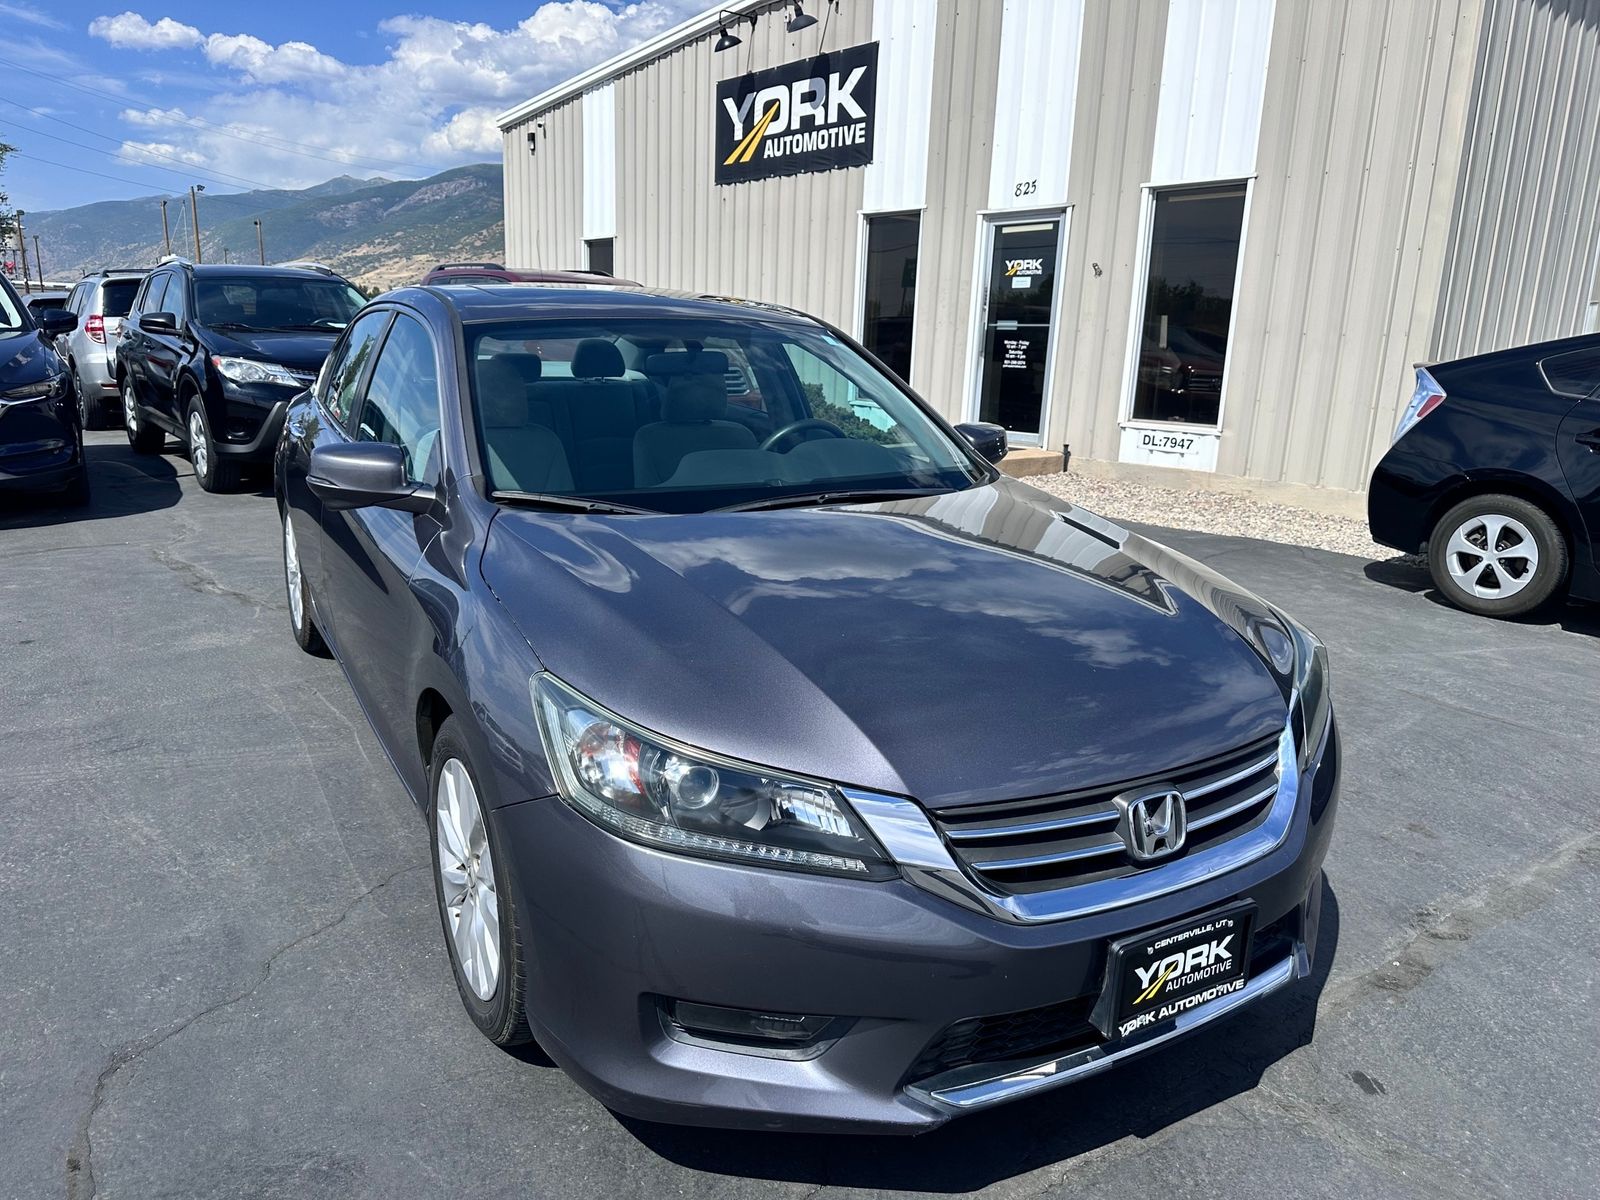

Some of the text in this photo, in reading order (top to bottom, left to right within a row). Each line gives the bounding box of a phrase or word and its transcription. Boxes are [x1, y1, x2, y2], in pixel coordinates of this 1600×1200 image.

[723, 66, 867, 141] YORK
[763, 122, 866, 159] AUTOMOTIVE
[1014, 179, 1037, 197] 825
[1005, 258, 1043, 271] YORK
[1142, 434, 1194, 450] DL:7947
[1154, 919, 1228, 949] CENTERVILLE, UT
[1134, 933, 1235, 989] YORK
[1165, 958, 1232, 992] AUTOMOTIVE
[1118, 978, 1245, 1037] YORK AUTOMOTIVE
